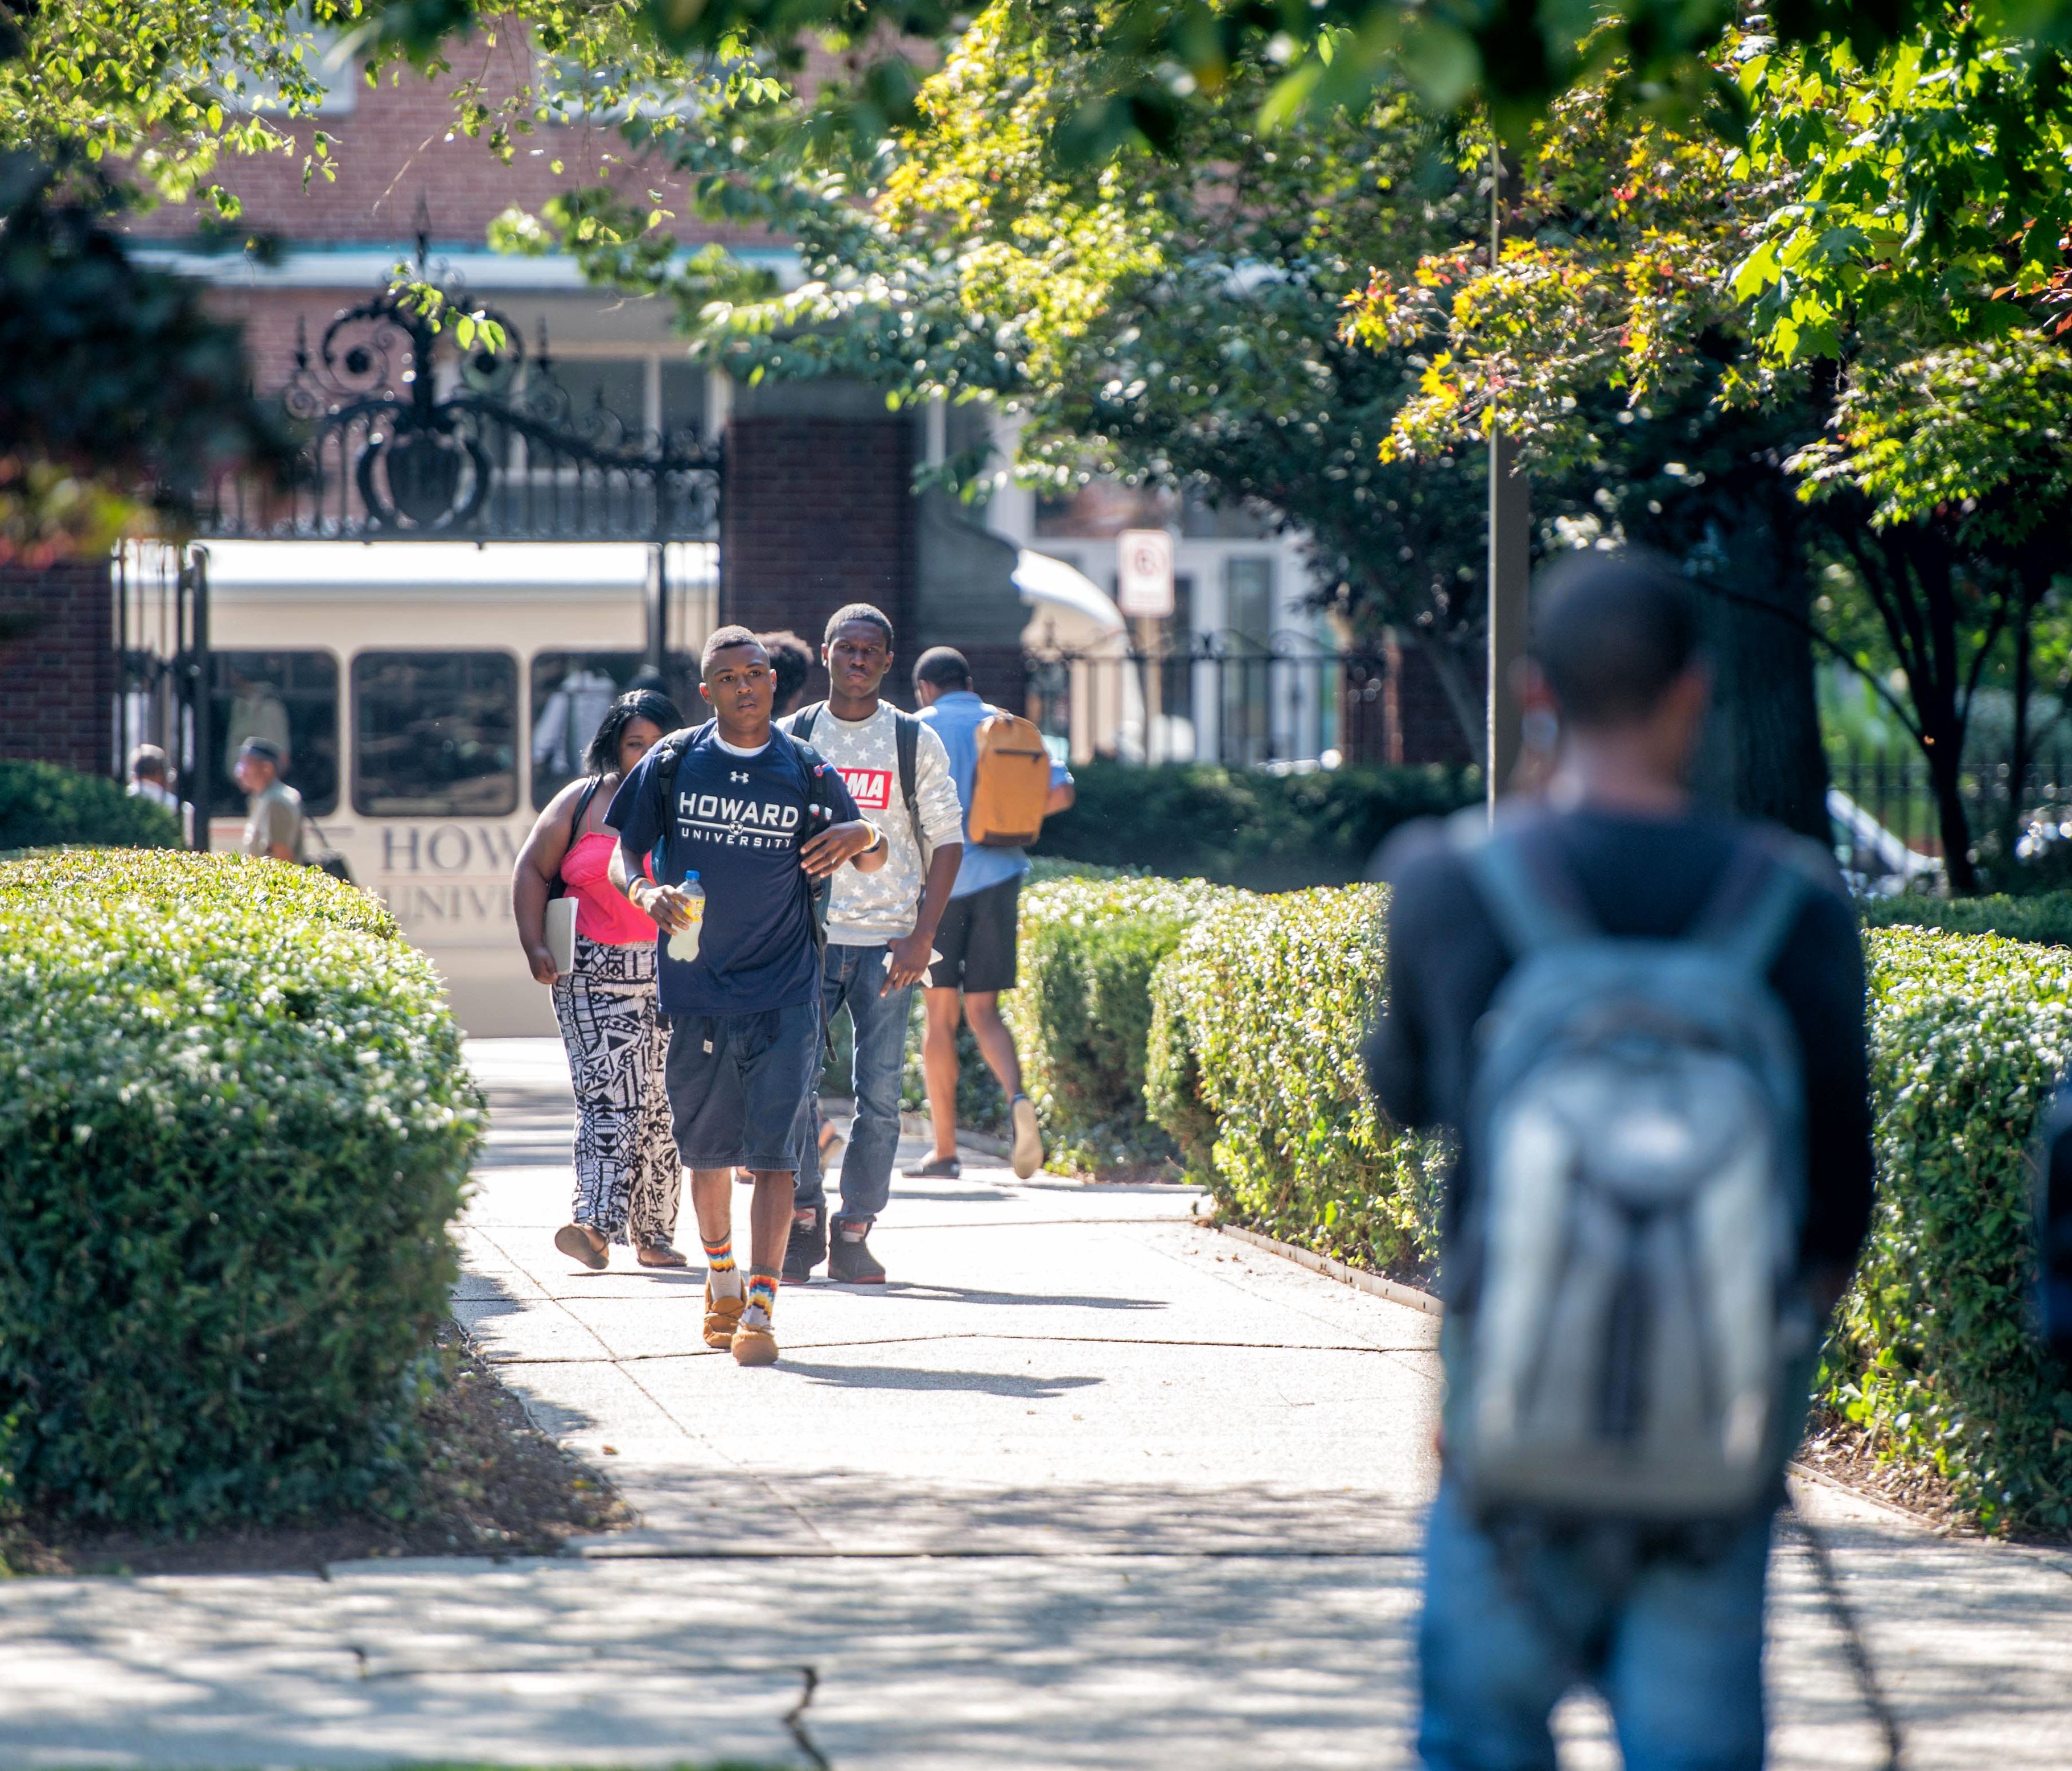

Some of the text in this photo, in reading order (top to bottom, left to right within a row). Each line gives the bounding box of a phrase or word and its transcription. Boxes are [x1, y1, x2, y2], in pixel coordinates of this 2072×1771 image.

[838, 772, 885, 799] MA
[680, 792, 799, 827] HOWARD
[681, 827, 791, 848] UNIVERSITY
